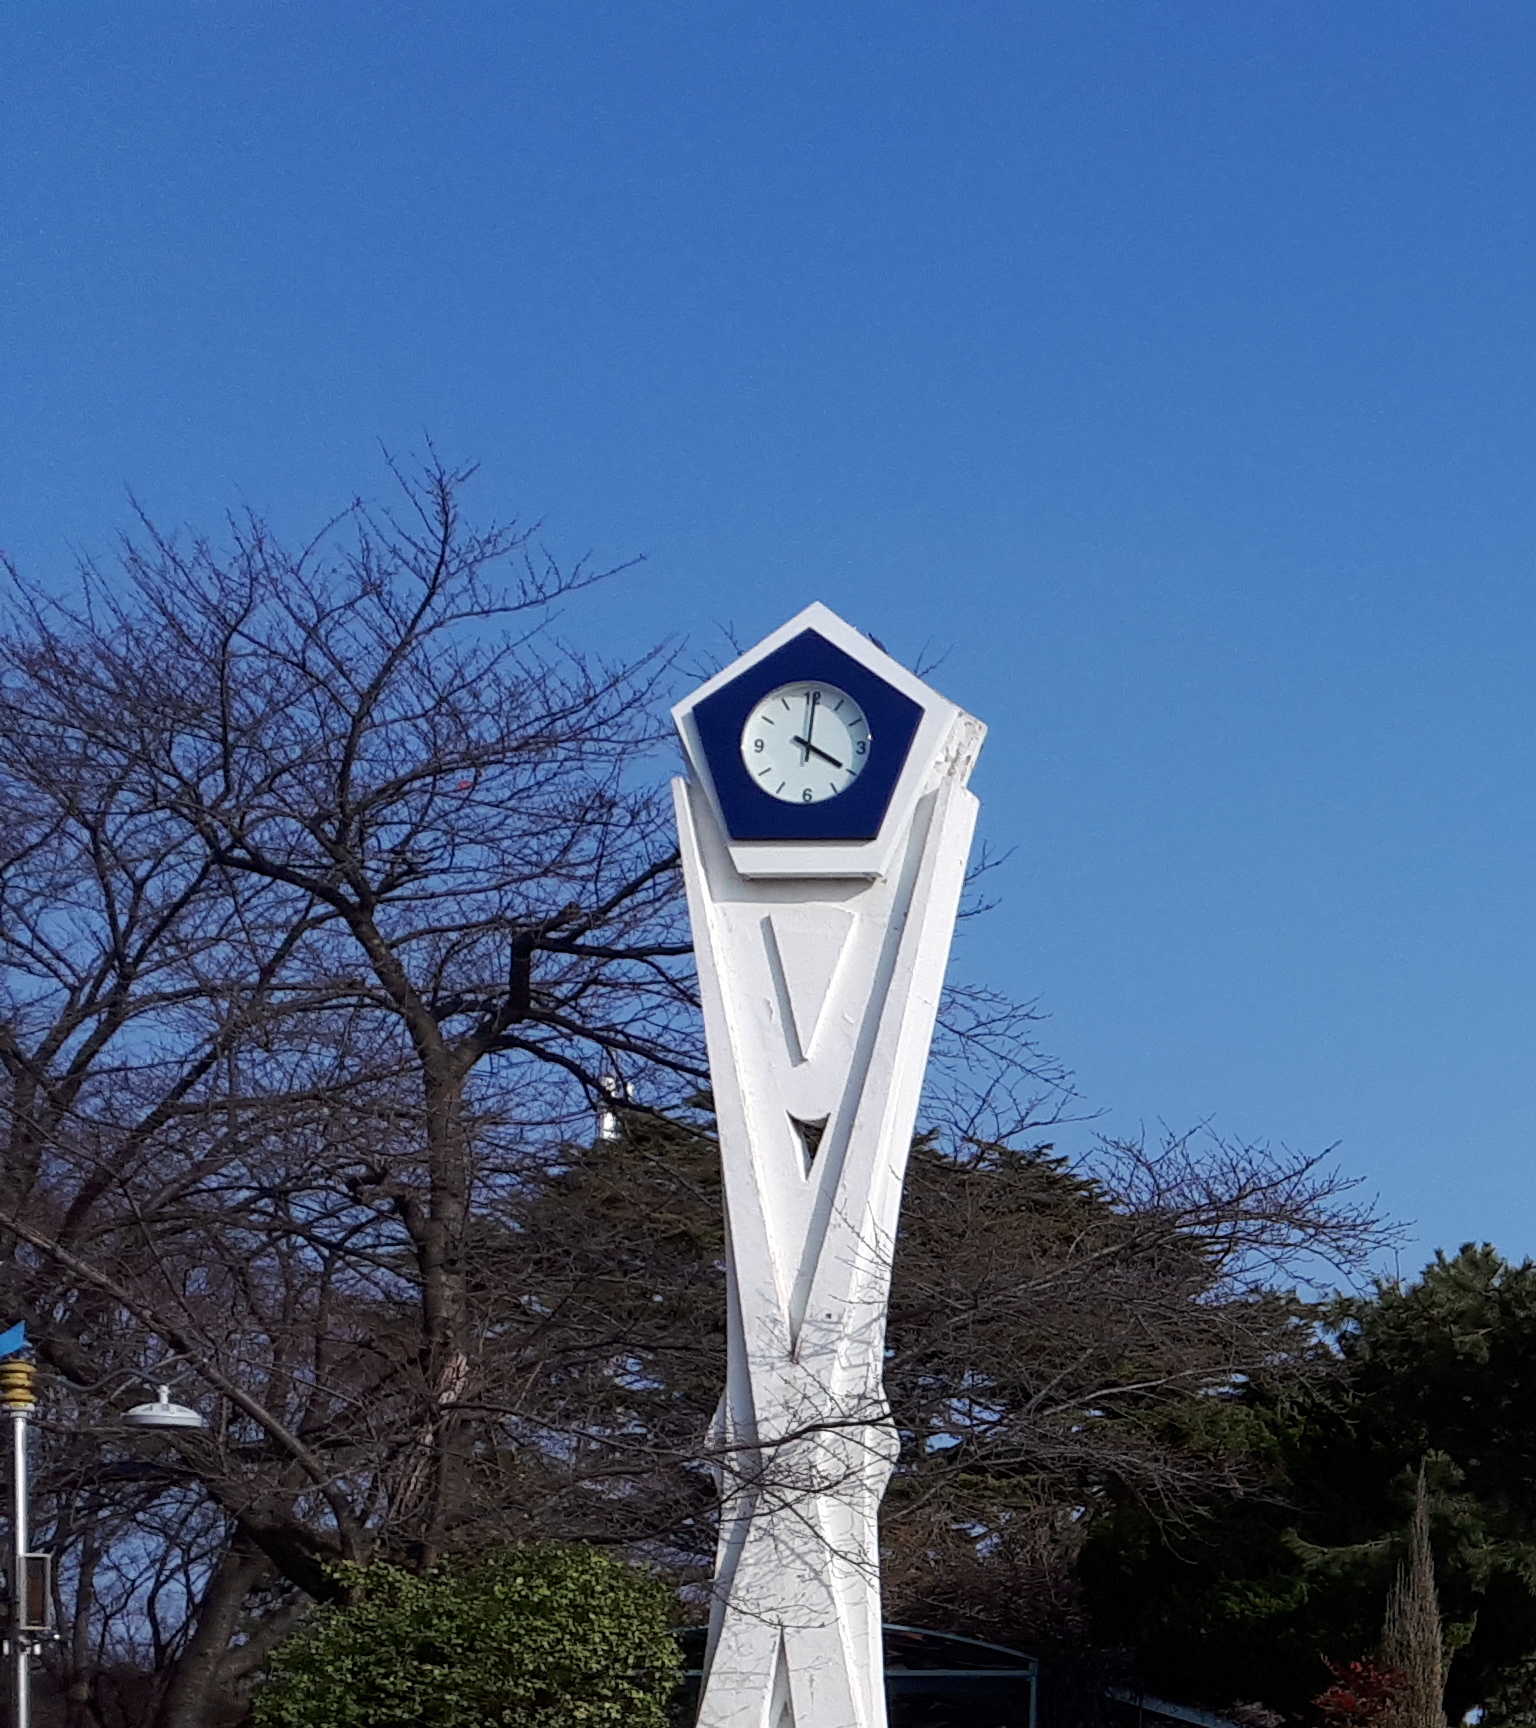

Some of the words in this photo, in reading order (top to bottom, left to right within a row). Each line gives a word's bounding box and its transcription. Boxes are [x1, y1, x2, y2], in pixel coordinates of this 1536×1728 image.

[804, 691, 821, 705] 12
[754, 739, 764, 753] 9
[856, 741, 866, 755] 3
[802, 788, 813, 802] 6
